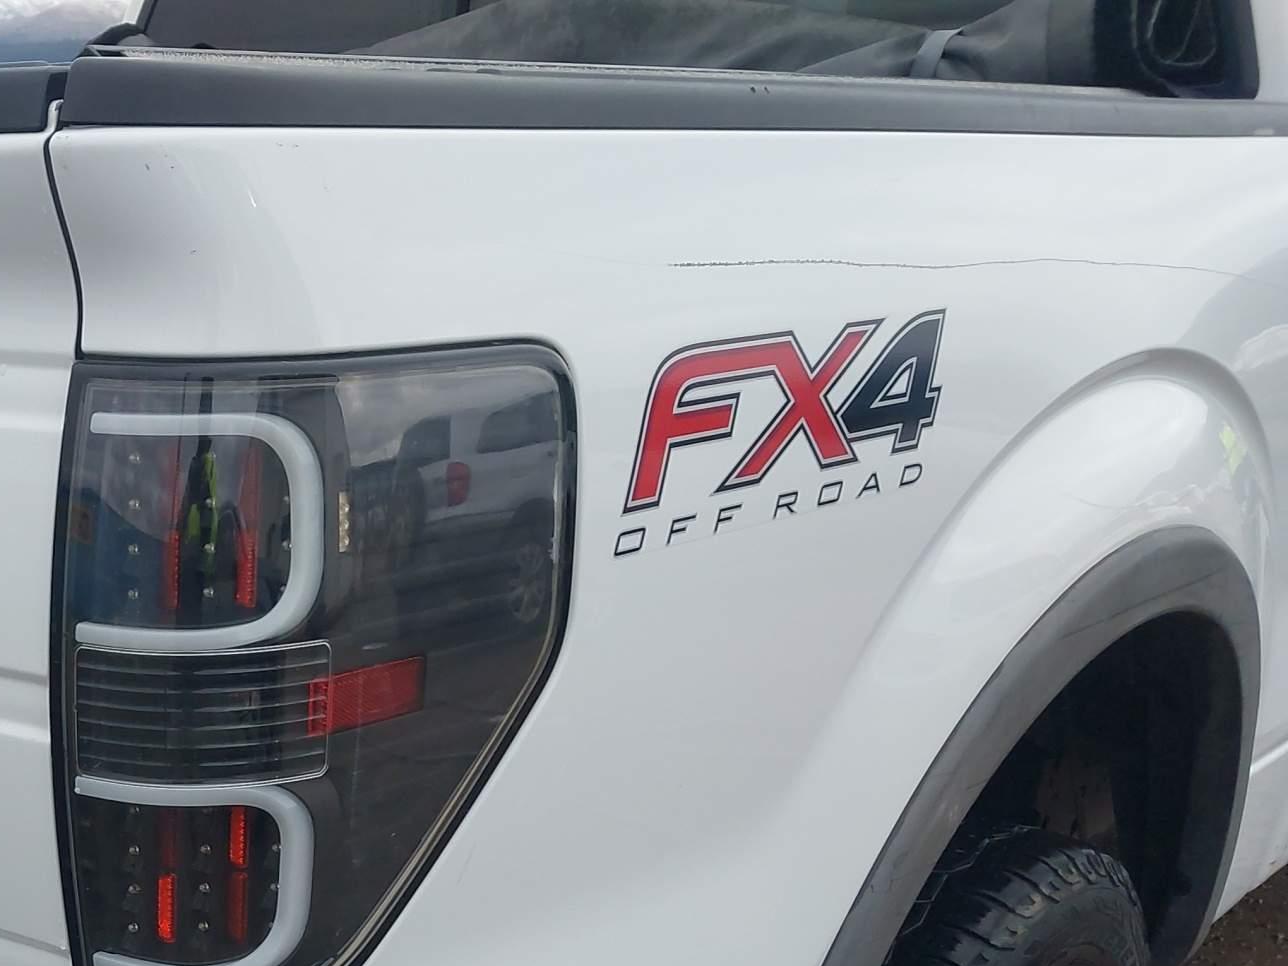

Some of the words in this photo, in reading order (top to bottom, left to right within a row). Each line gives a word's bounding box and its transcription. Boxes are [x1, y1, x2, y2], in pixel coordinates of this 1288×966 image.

[622, 308, 947, 515] FX4
[613, 503, 743, 558] OFF
[773, 463, 923, 520] ROAD
